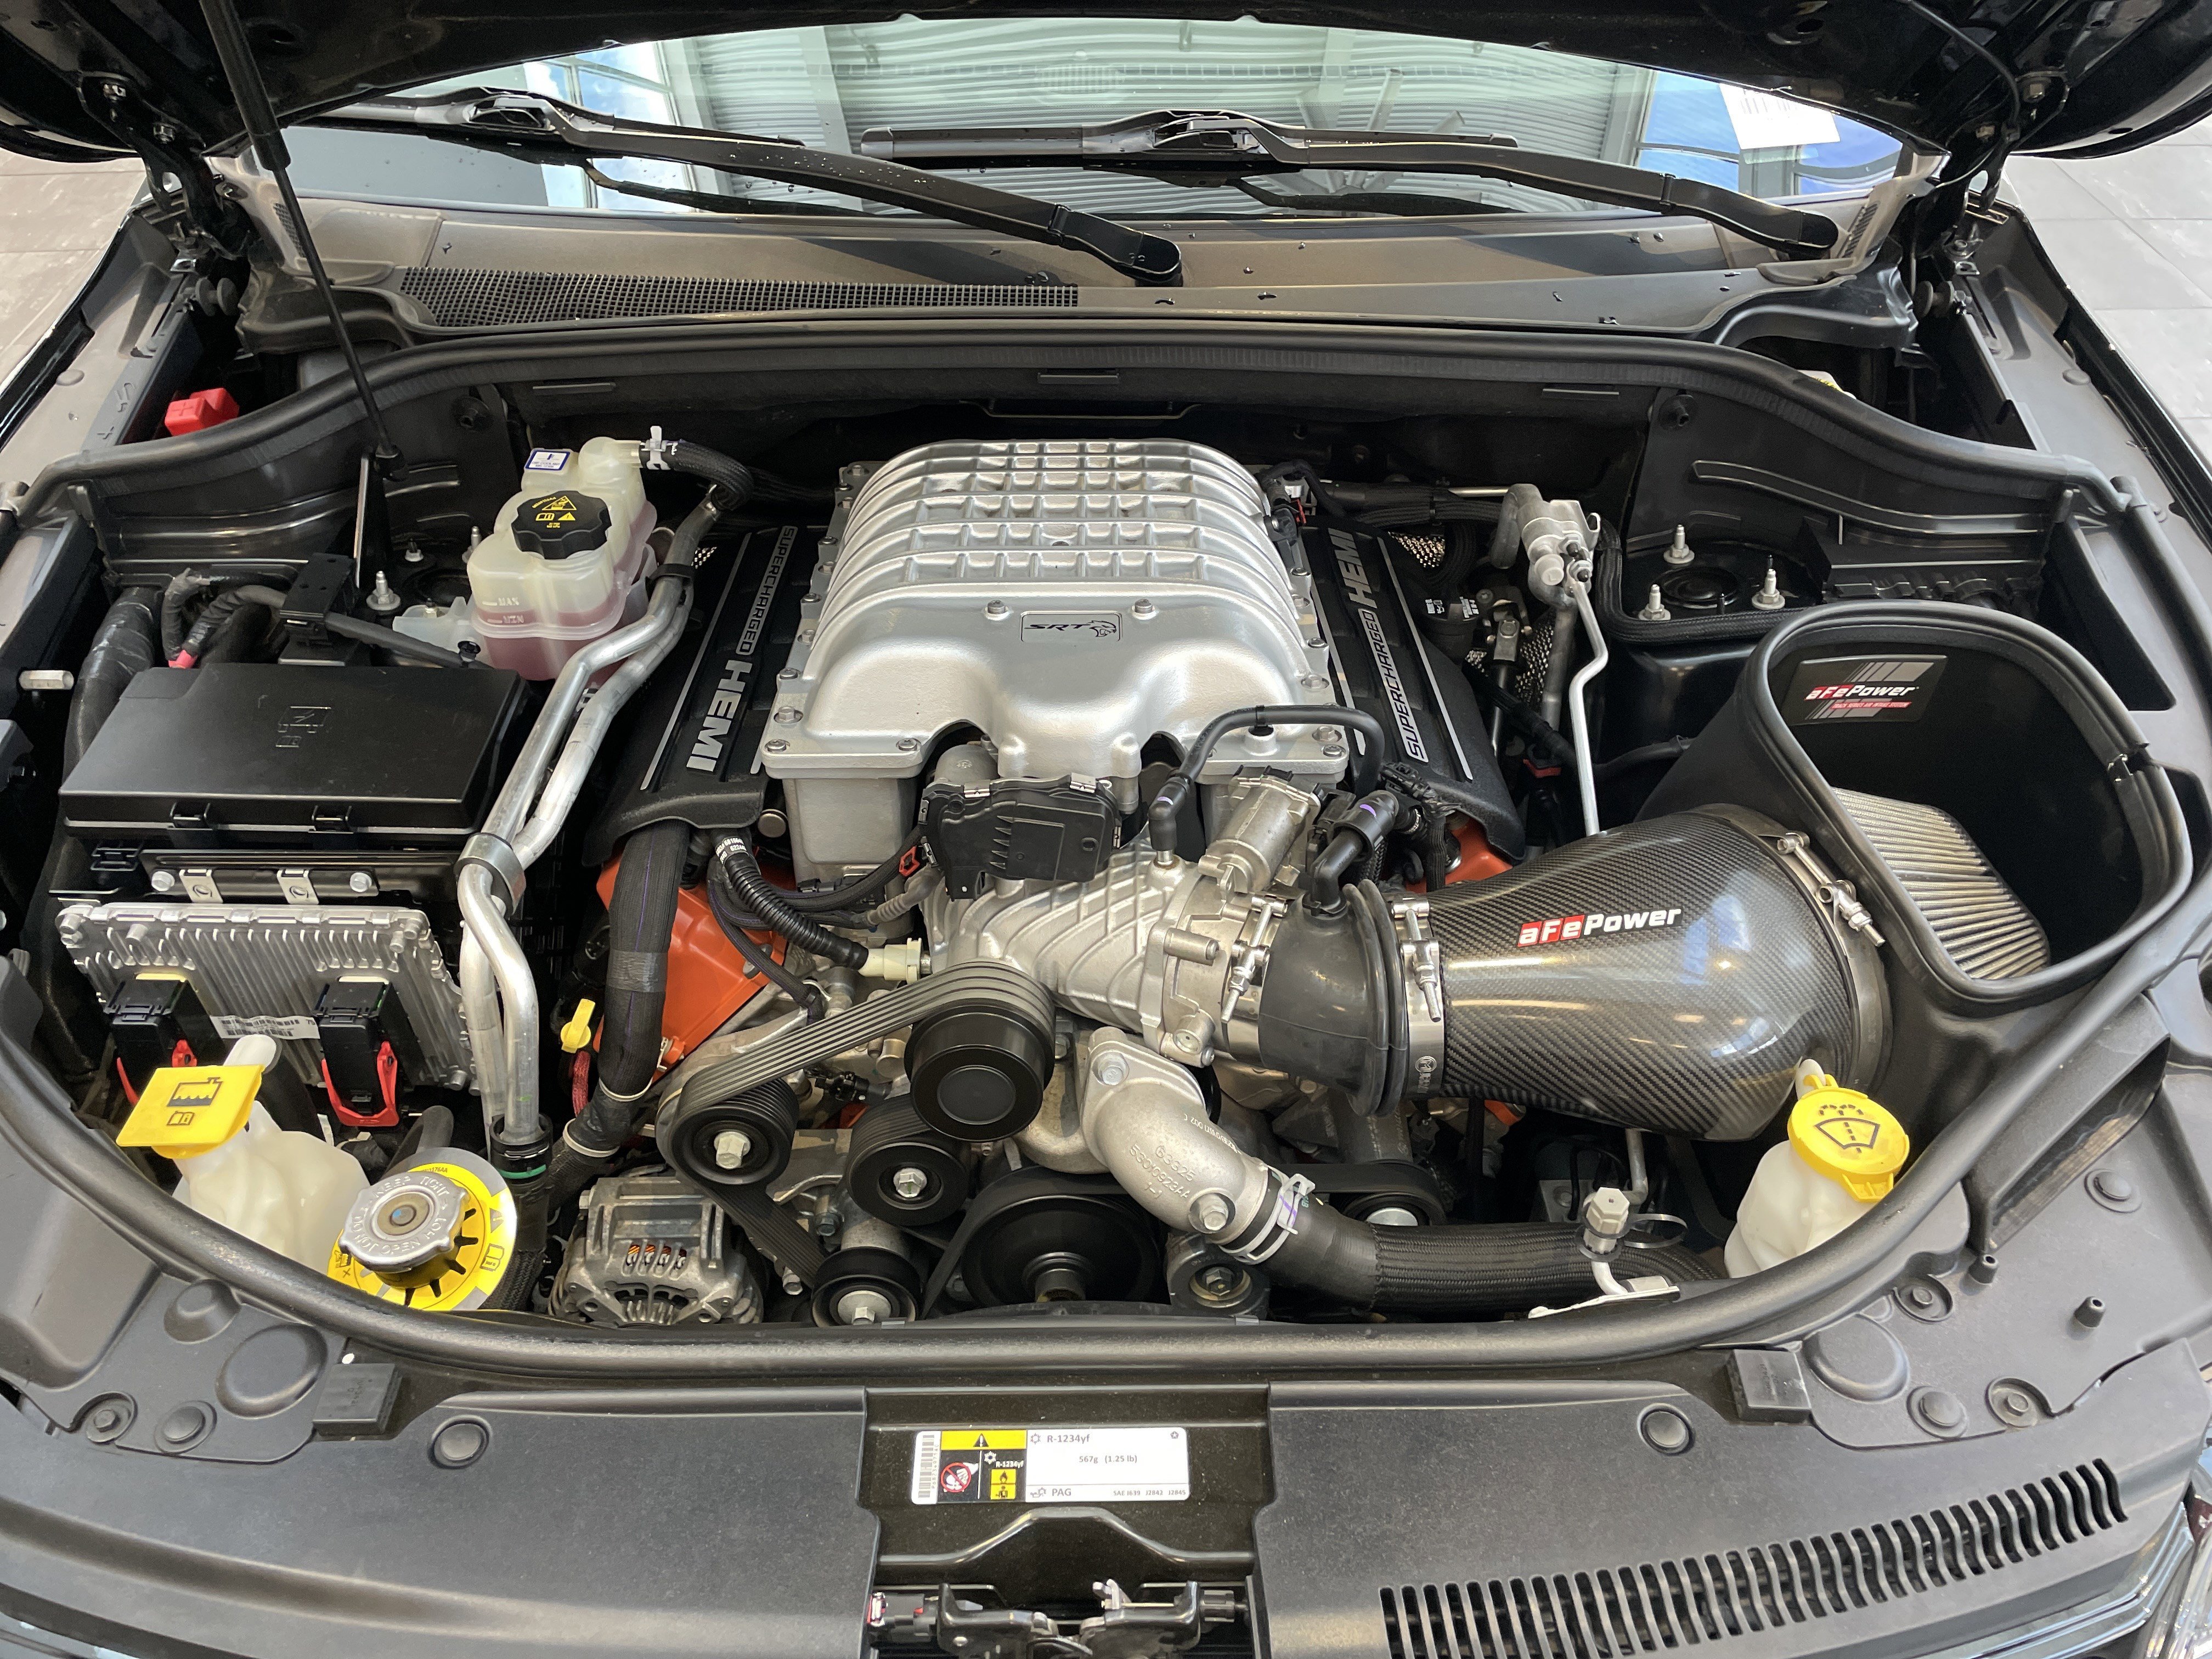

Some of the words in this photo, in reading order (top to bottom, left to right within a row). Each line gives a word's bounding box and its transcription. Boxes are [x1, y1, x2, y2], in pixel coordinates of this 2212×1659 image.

[1328, 528, 1378, 608] HEMI
[738, 527, 797, 653] SUPERCHARGED
[498, 597, 519, 606] MAX
[503, 615, 524, 623] MIN
[1362, 611, 1426, 760] SUPERCHARGED
[1805, 685, 1915, 700] aFePower
[686, 659, 753, 771] HEMI
[1519, 909, 1682, 944] aFePower
[373, 1176, 411, 1198] KEEP
[354, 1233, 379, 1252] NOT
[382, 1237, 421, 1255] OPEN
[1047, 1434, 1090, 1444] R-1234yf
[995, 1460, 1024, 1469] R-1234yf
[1079, 1455, 1098, 1464] 567g
[1104, 1455, 1125, 1464] (1.25
[1127, 1454, 1137, 1464] lb)
[1052, 1488, 1071, 1497] PAG
